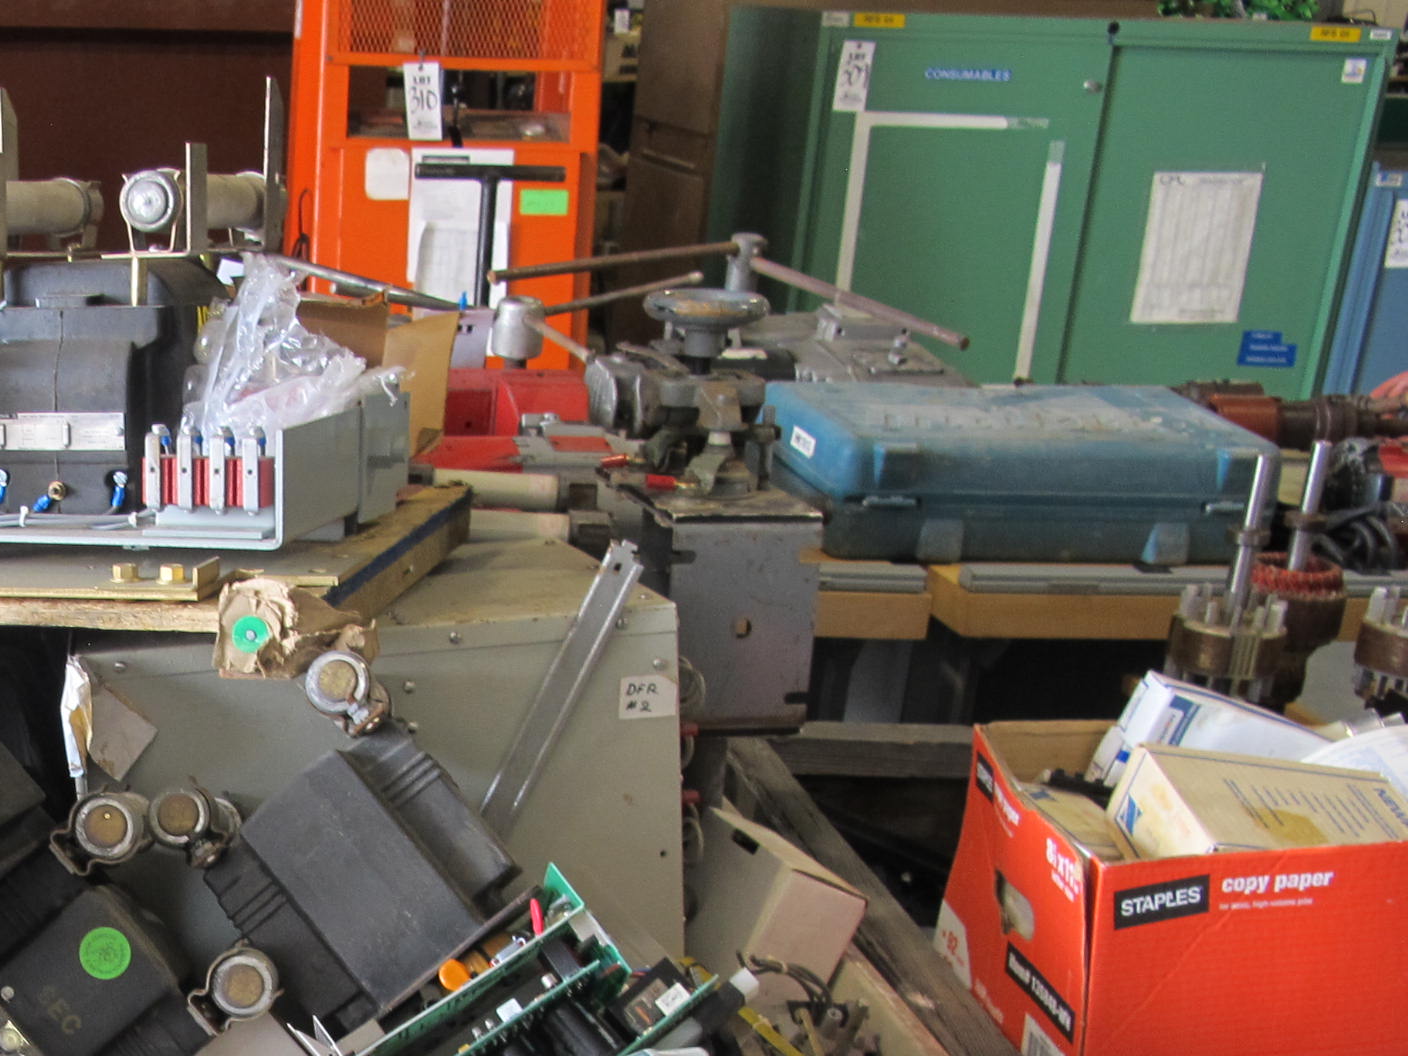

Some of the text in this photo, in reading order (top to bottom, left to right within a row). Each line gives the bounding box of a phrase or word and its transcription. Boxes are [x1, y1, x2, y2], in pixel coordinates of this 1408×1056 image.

[924, 67, 1012, 82] CONSUMABLES
[410, 86, 439, 114] 310
[625, 682, 659, 696] DFR
[1221, 871, 1335, 895] copy paper
[1120, 886, 1204, 917] STAPLES
